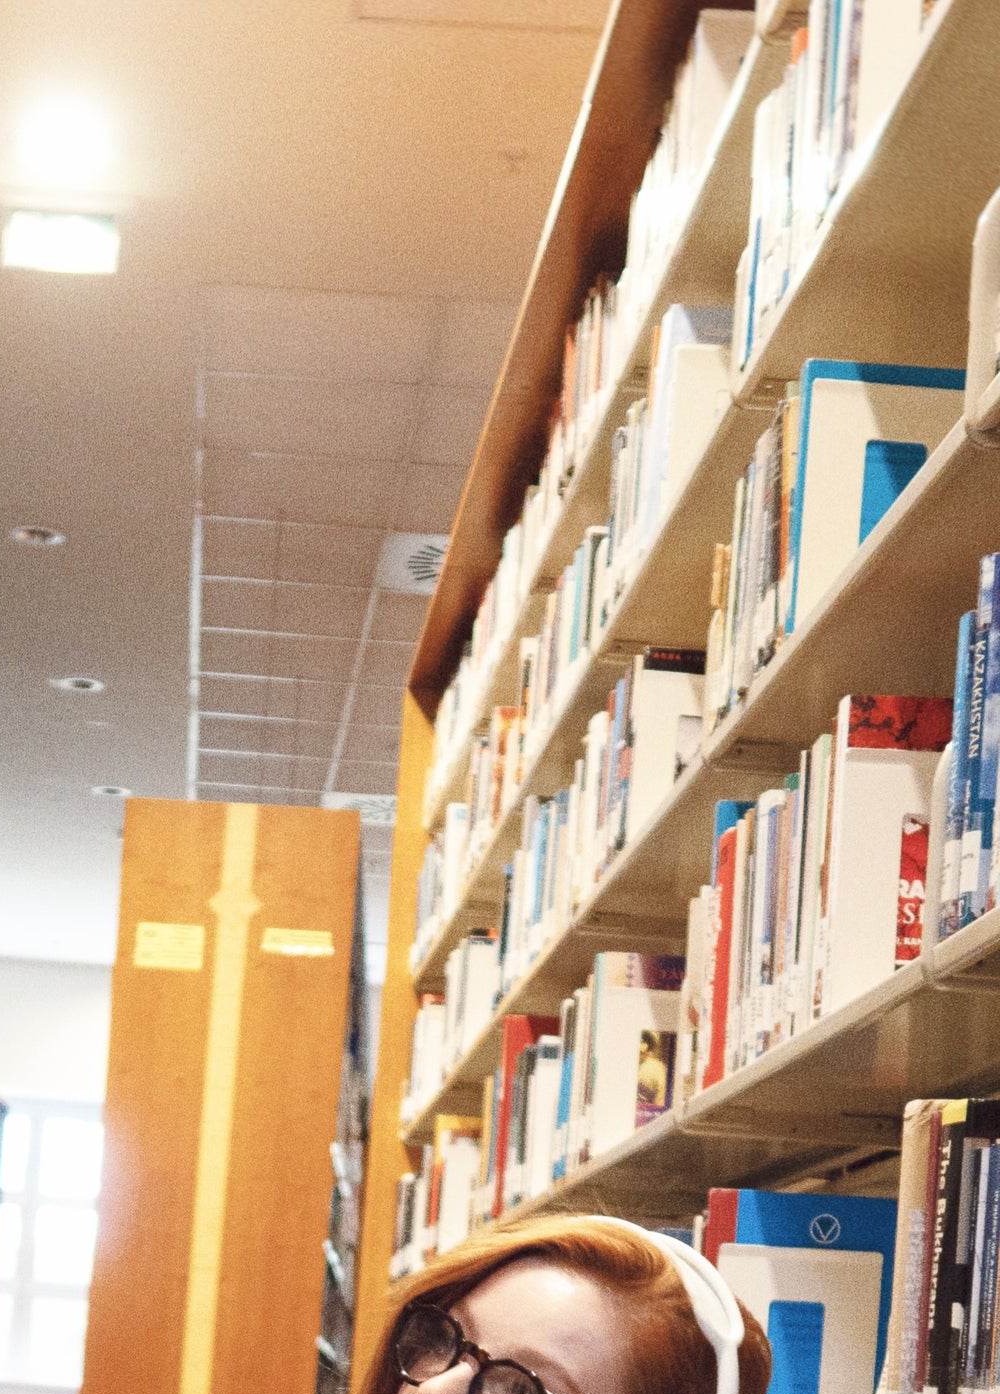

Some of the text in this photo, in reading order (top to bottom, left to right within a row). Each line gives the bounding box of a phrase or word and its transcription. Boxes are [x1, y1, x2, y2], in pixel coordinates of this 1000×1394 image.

[969, 640, 986, 759] KAZAKHSTAN
[928, 1140, 952, 1330] The Bukharans
